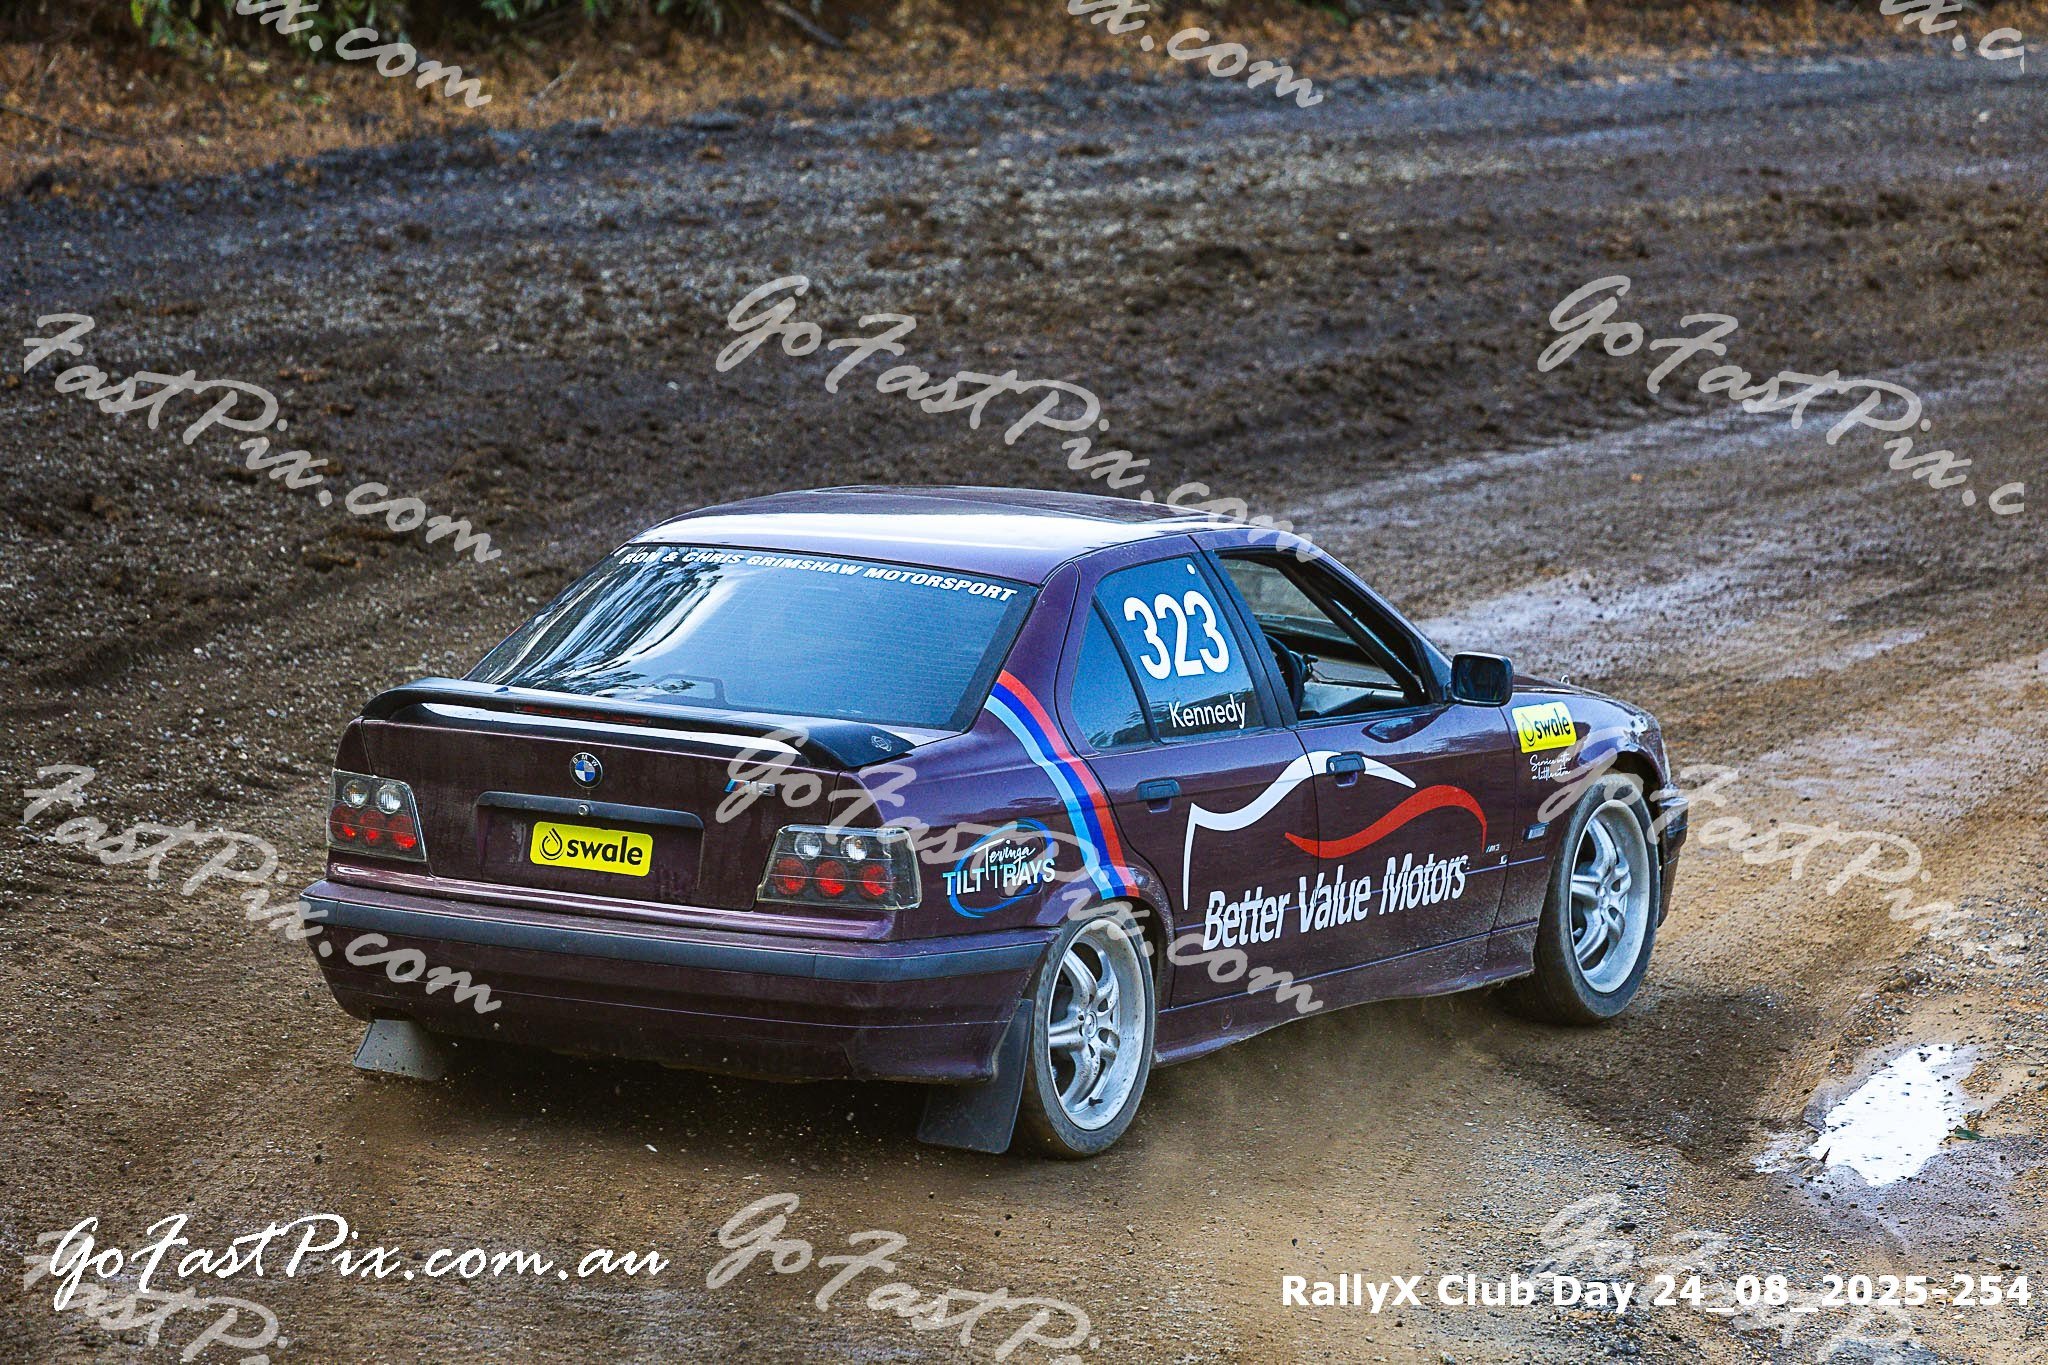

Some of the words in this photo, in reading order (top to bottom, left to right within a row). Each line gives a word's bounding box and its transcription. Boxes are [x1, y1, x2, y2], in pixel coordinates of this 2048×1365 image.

[619, 551, 663, 565] RON
[662, 551, 678, 563] &
[681, 551, 744, 564] CHRIS
[746, 556, 863, 576] GRIMSHAW
[862, 567, 1018, 602] MOTORSPORT
[1123, 590, 1230, 680] 323
[1168, 694, 1246, 729] Kennedy
[1534, 707, 1571, 739] swale
[566, 836, 643, 866] swale
[942, 867, 985, 896] TILT
[990, 858, 1056, 889] TRAYS
[1202, 886, 1291, 951] Better
[1298, 864, 1371, 933] Value
[1378, 852, 1468, 915] Motors
